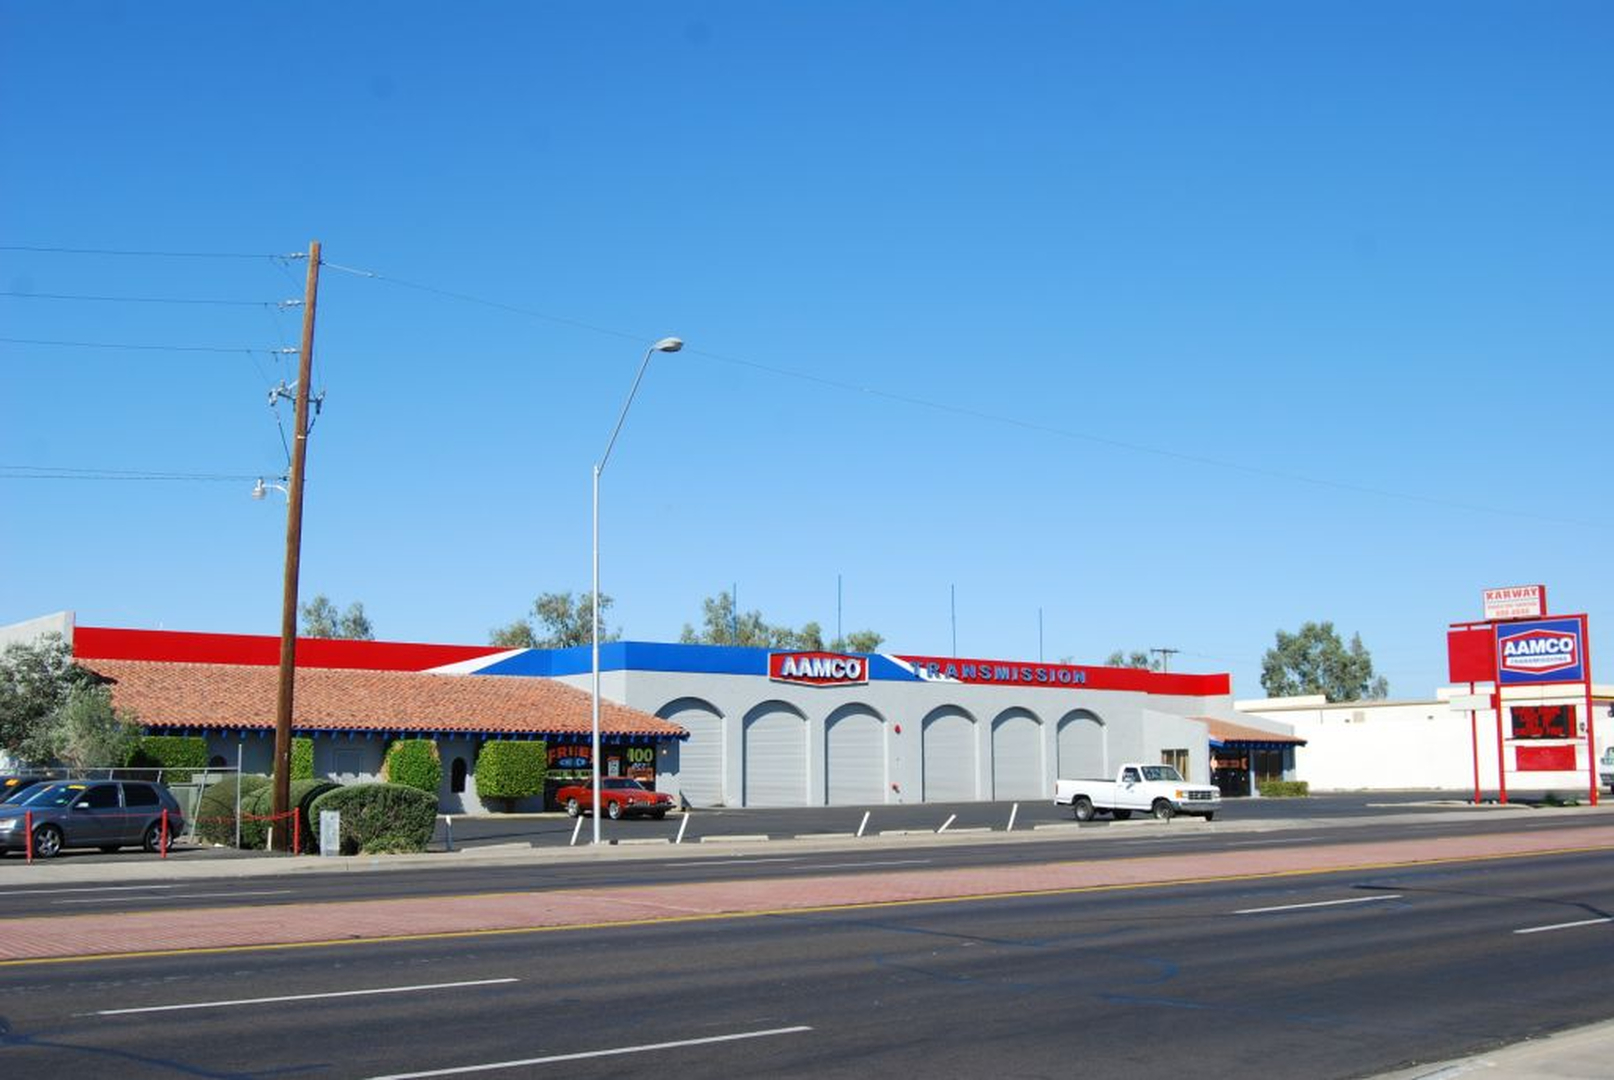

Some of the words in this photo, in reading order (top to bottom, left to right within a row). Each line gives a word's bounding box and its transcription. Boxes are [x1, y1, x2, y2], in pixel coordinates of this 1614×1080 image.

[1486, 588, 1538, 600] KARWAY
[1504, 637, 1574, 656] AAMCO
[781, 656, 862, 679] AAMCO
[910, 661, 1087, 684] TRANSMISSION
